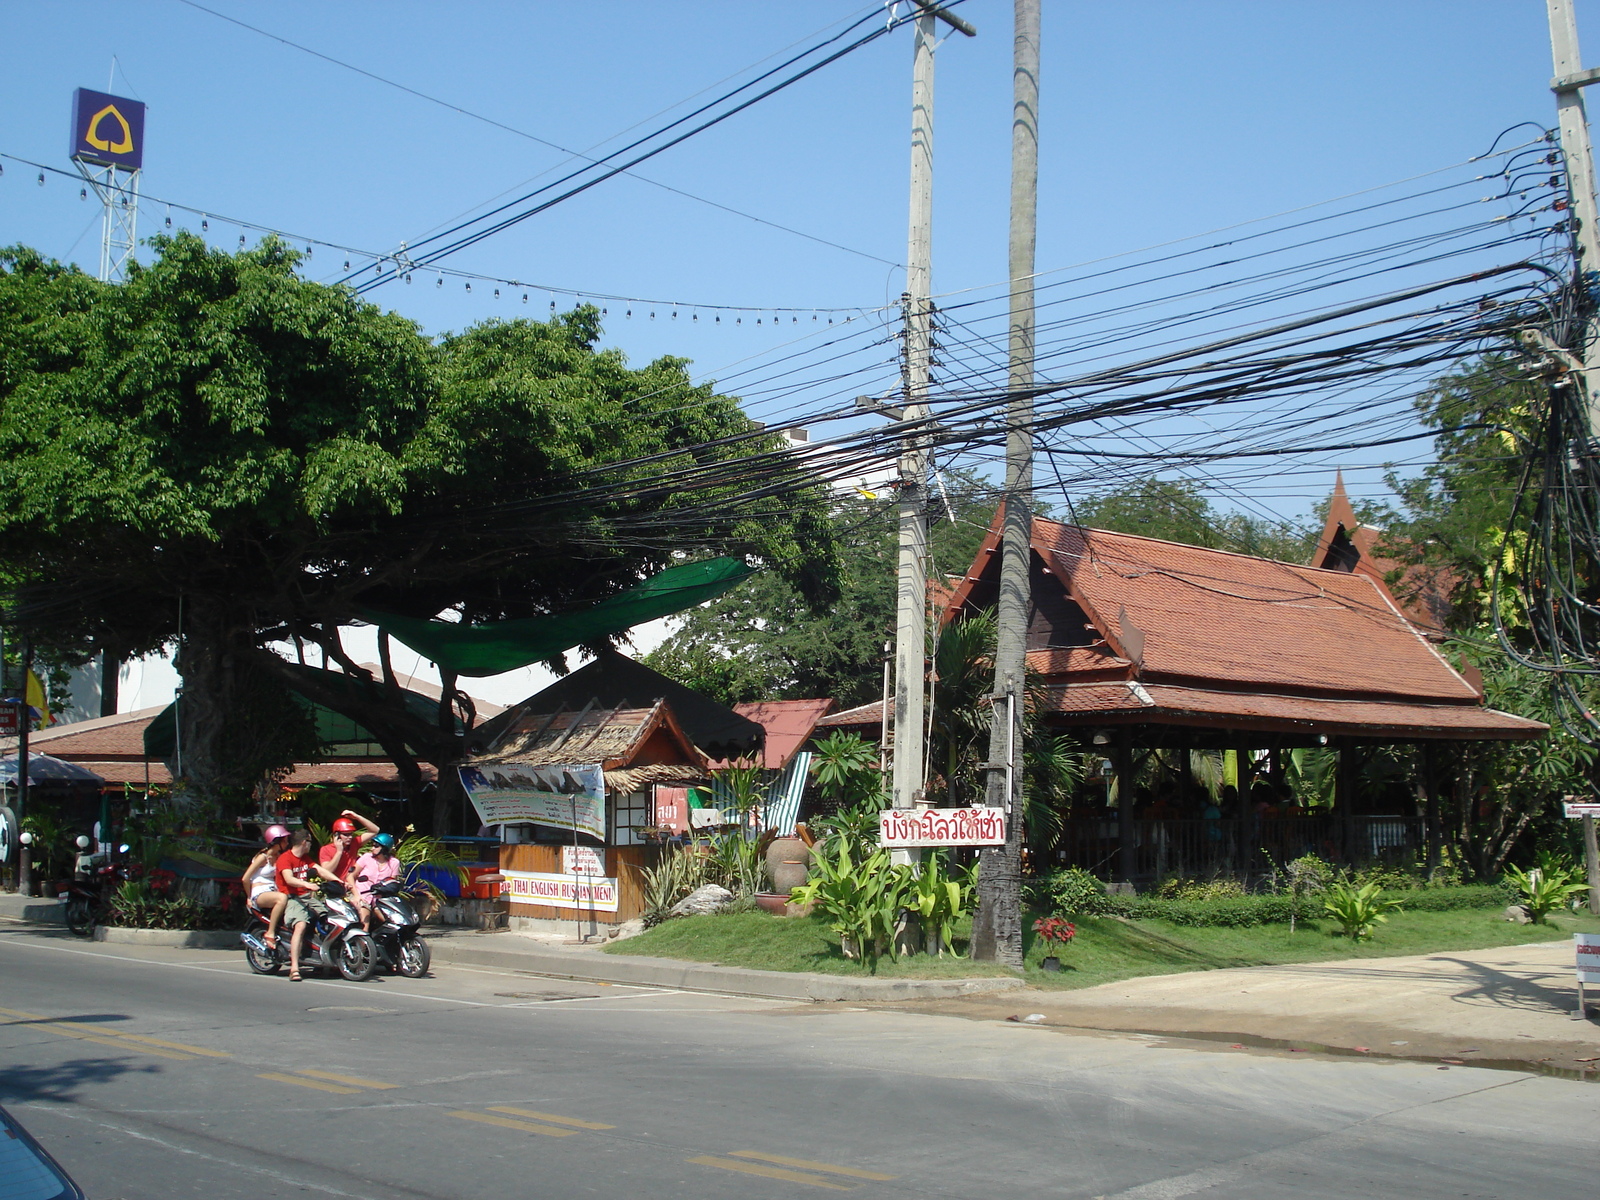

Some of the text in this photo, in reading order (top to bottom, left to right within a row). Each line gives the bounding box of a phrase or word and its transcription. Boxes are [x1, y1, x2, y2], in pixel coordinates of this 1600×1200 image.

[882, 809, 1004, 840] บังกะโลว์ให้เช่า
[513, 879, 528, 894] THAI
[530, 881, 559, 897] ENGLISH
[562, 883, 592, 899] RUSIAN
[593, 886, 614, 901] MENU
